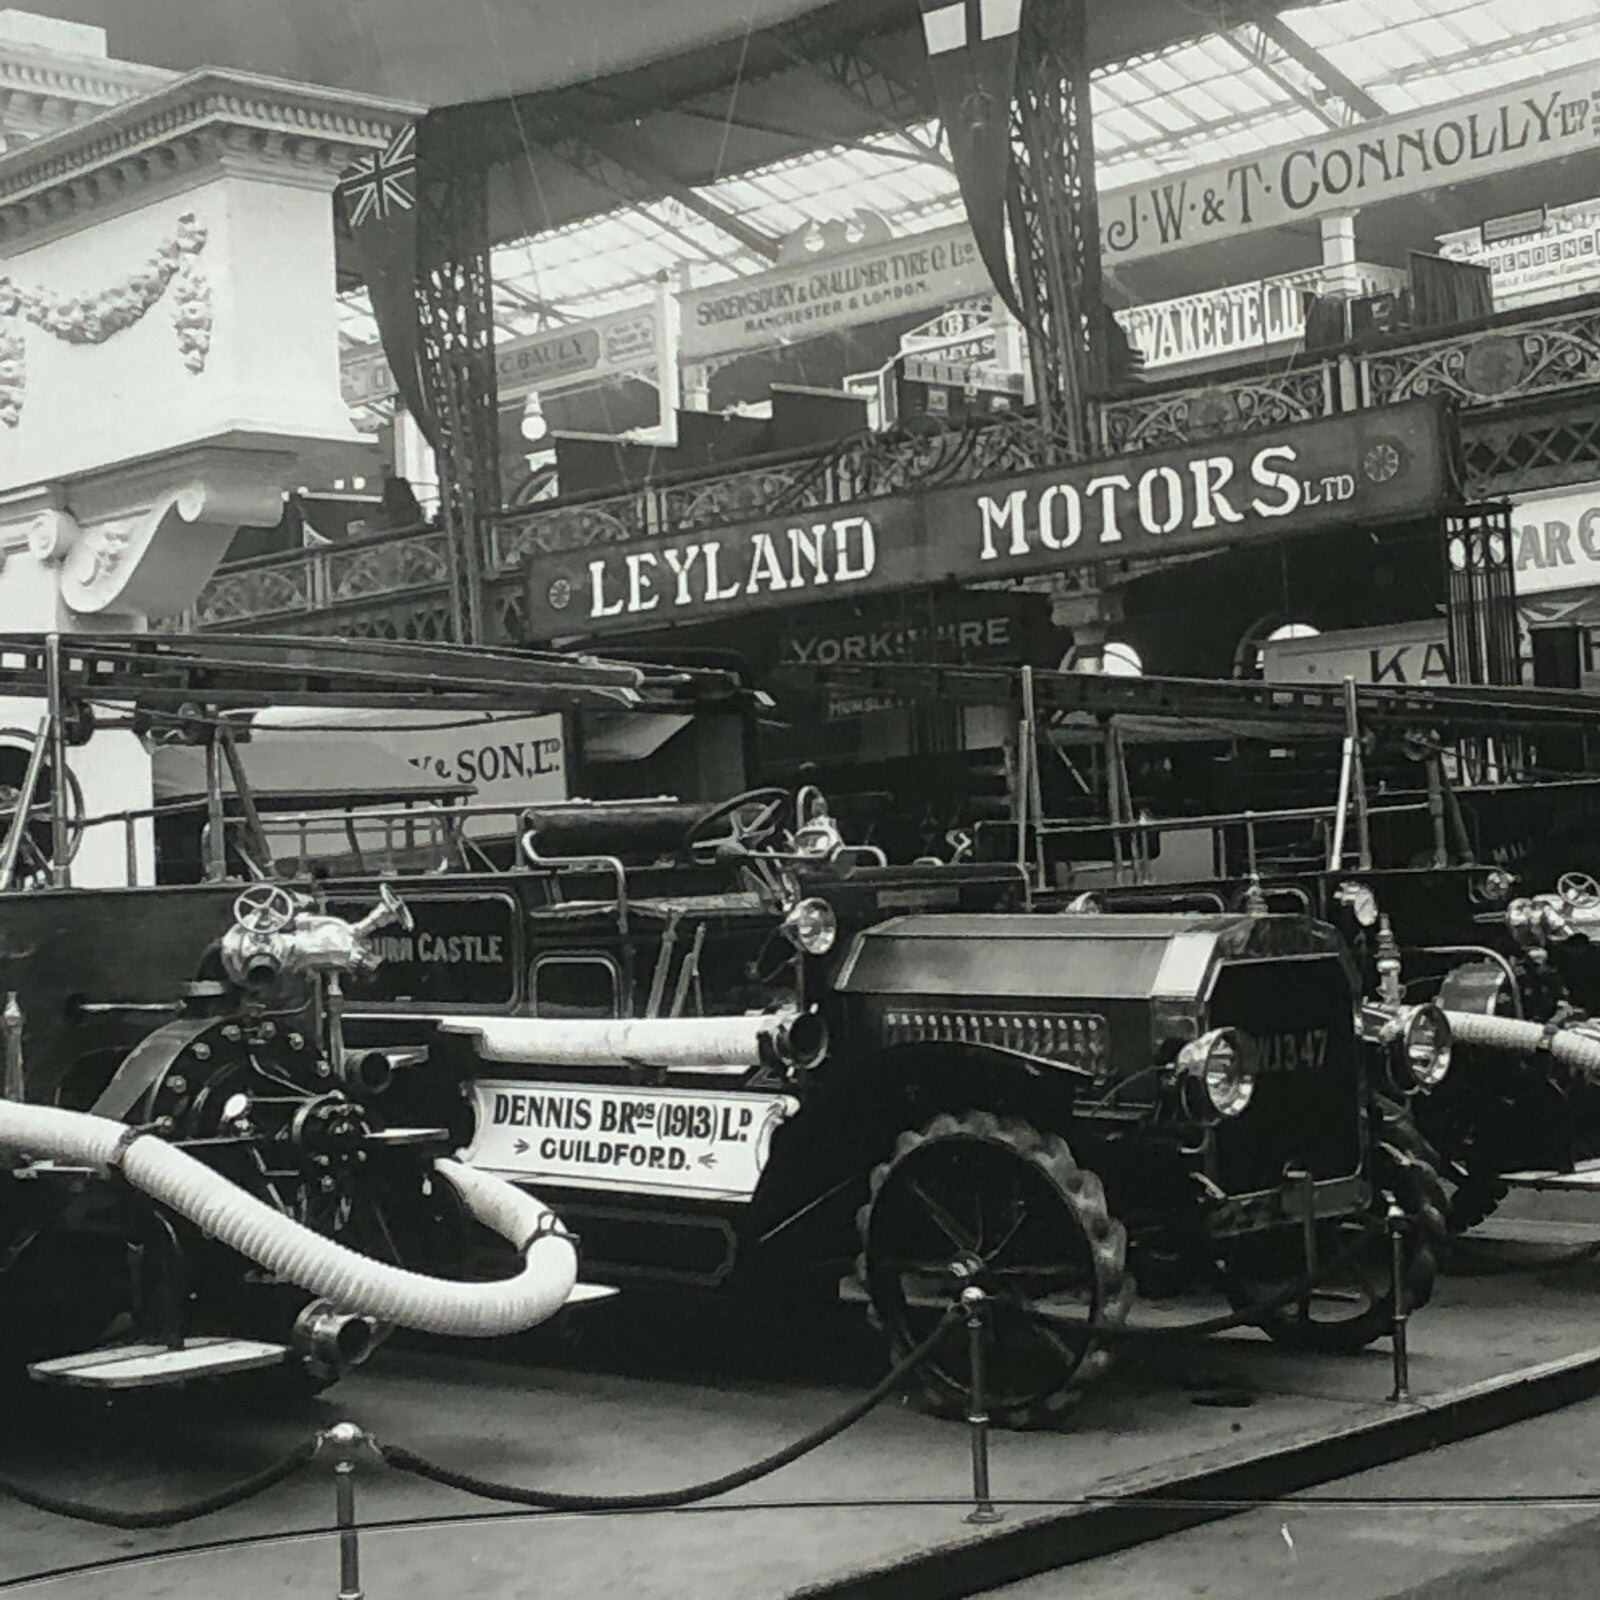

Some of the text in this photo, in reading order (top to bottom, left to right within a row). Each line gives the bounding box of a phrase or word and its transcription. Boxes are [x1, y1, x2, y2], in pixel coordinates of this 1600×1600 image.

[1280, 91, 1562, 210] CONNOLLY
[890, 247, 930, 282] TYRE
[588, 444, 1355, 618] LEYLAND MOTORS LTD
[417, 932, 504, 964] CASTLE
[492, 1093, 592, 1131] DENNIS
[539, 1137, 692, 1172] GUILDFORD.
